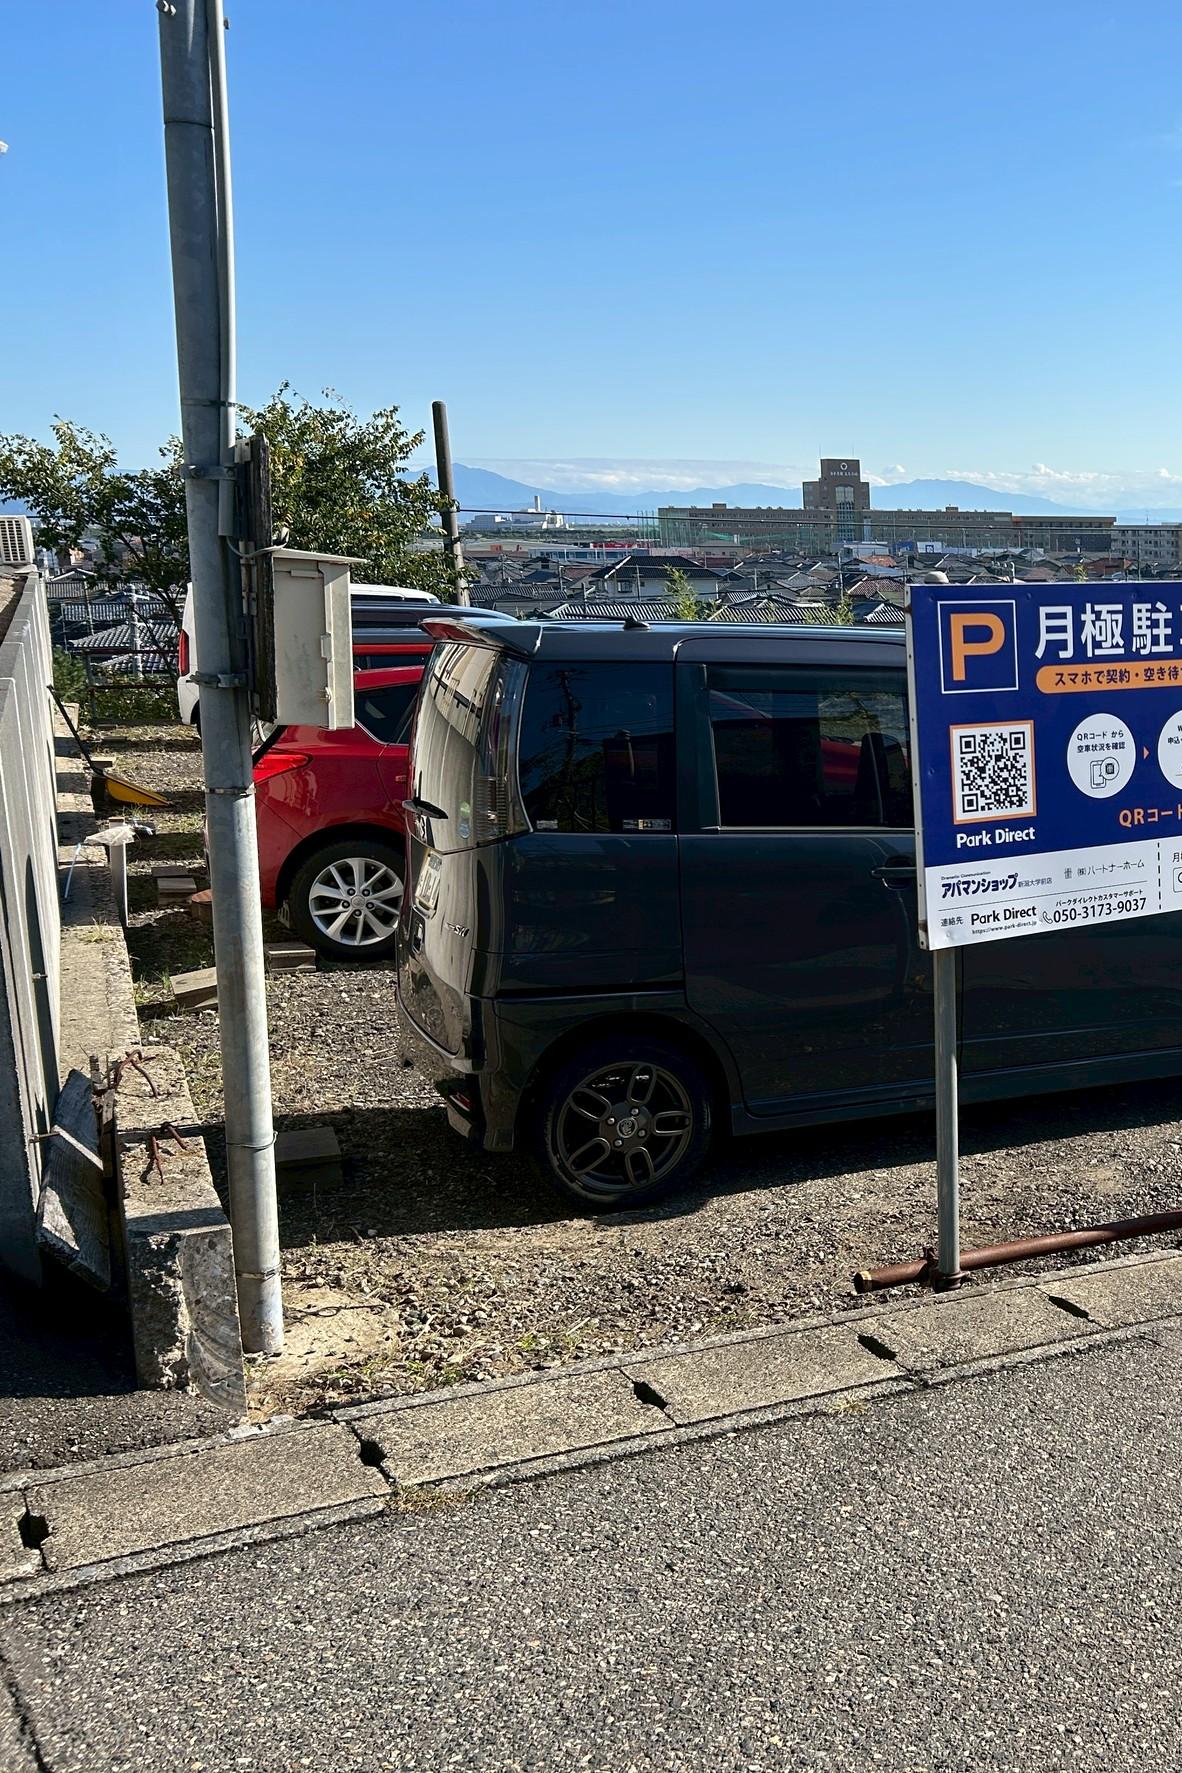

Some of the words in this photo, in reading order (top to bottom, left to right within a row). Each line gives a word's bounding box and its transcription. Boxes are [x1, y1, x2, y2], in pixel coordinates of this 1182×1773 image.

[950, 612, 1006, 682] P
[1076, 741, 1126, 753] 空車状況を確認
[956, 832, 993, 849] Park
[995, 826, 1036, 844] Direct
[941, 872, 1019, 899] アパマンショップ
[940, 916, 964, 927] 連絡先
[970, 910, 1001, 926] Park
[1003, 905, 1037, 921] Direct
[1053, 896, 1147, 924] 050-3173-9037
